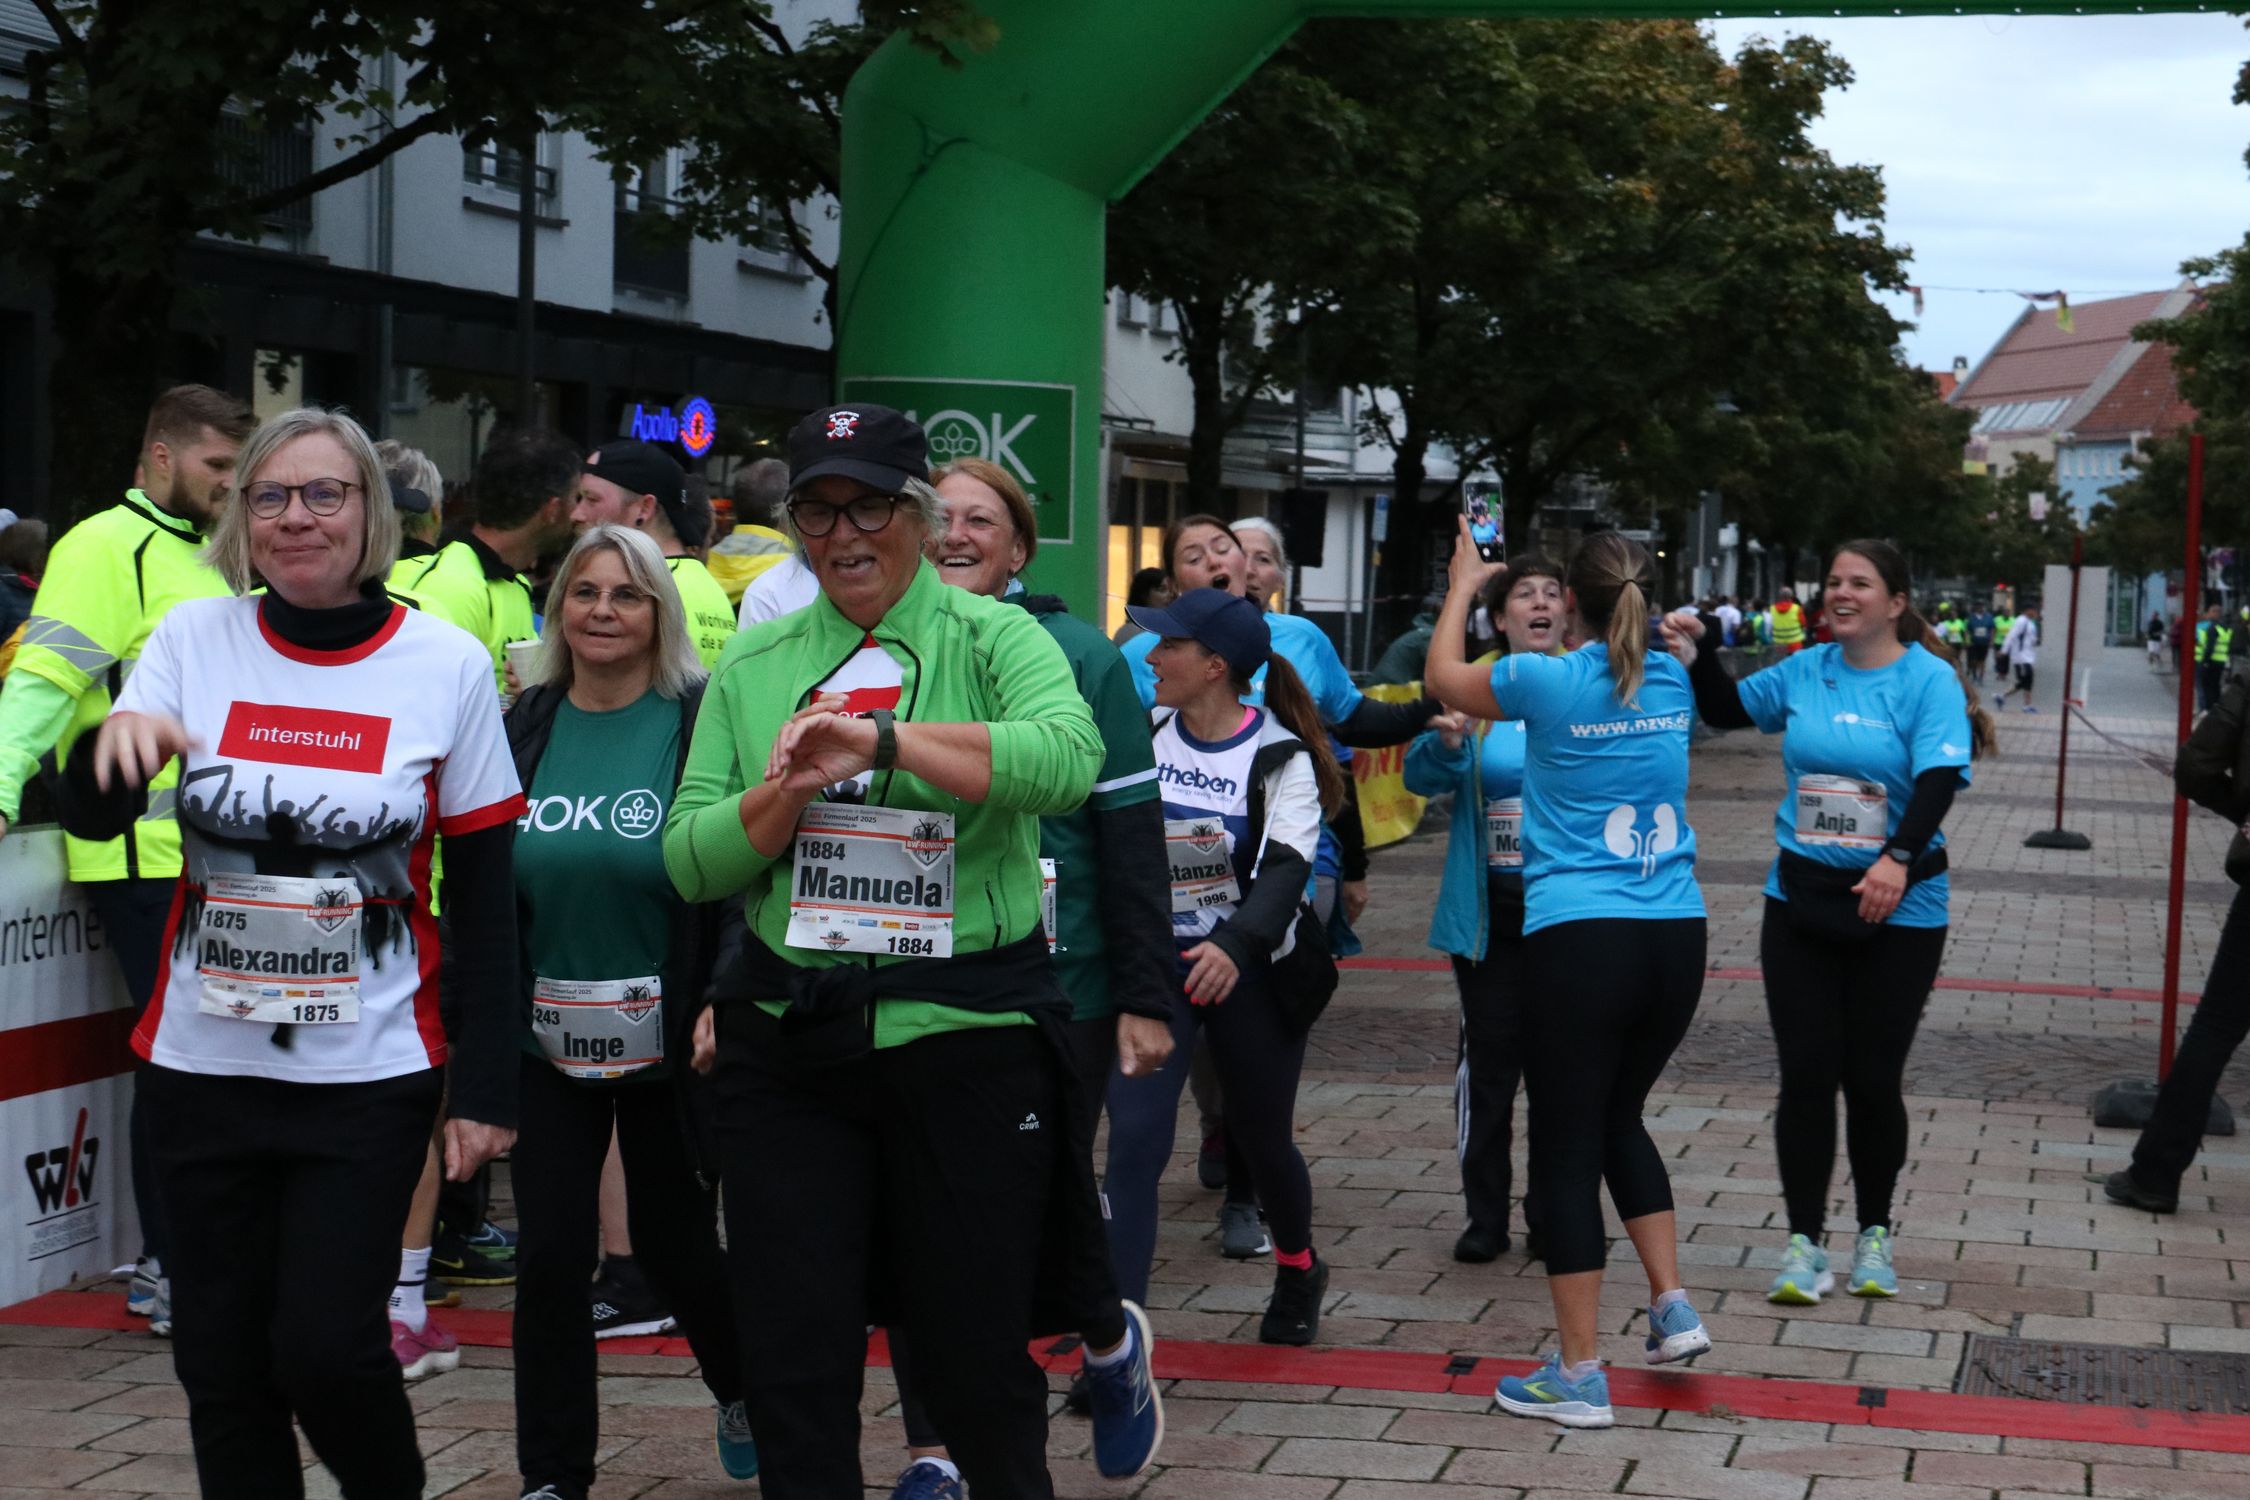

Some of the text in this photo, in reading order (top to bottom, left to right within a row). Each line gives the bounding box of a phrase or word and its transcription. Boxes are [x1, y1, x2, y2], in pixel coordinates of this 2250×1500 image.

[631, 403, 678, 443] Apollo
[905, 409, 1037, 484] OK
[249, 723, 361, 750] interstuhl
[1157, 763, 1237, 796] theben
[516, 795, 607, 832] AOK
[1814, 812, 1857, 835] Anja
[1489, 821, 1512, 830] 1271
[801, 840, 846, 861] 1884
[907, 841, 946, 850] BW-RUNNING
[260, 885, 277, 893] 2025
[800, 866, 942, 907] Manuela
[1196, 892, 1228, 907] 1996
[205, 909, 248, 931] 1875
[309, 907, 352, 916] BW-RUNNING
[0, 905, 110, 967] nterne
[887, 937, 933, 955] 1884
[205, 939, 348, 975] Alexandra
[293, 1005, 339, 1022] 1875
[564, 1032, 624, 1064] Inge
